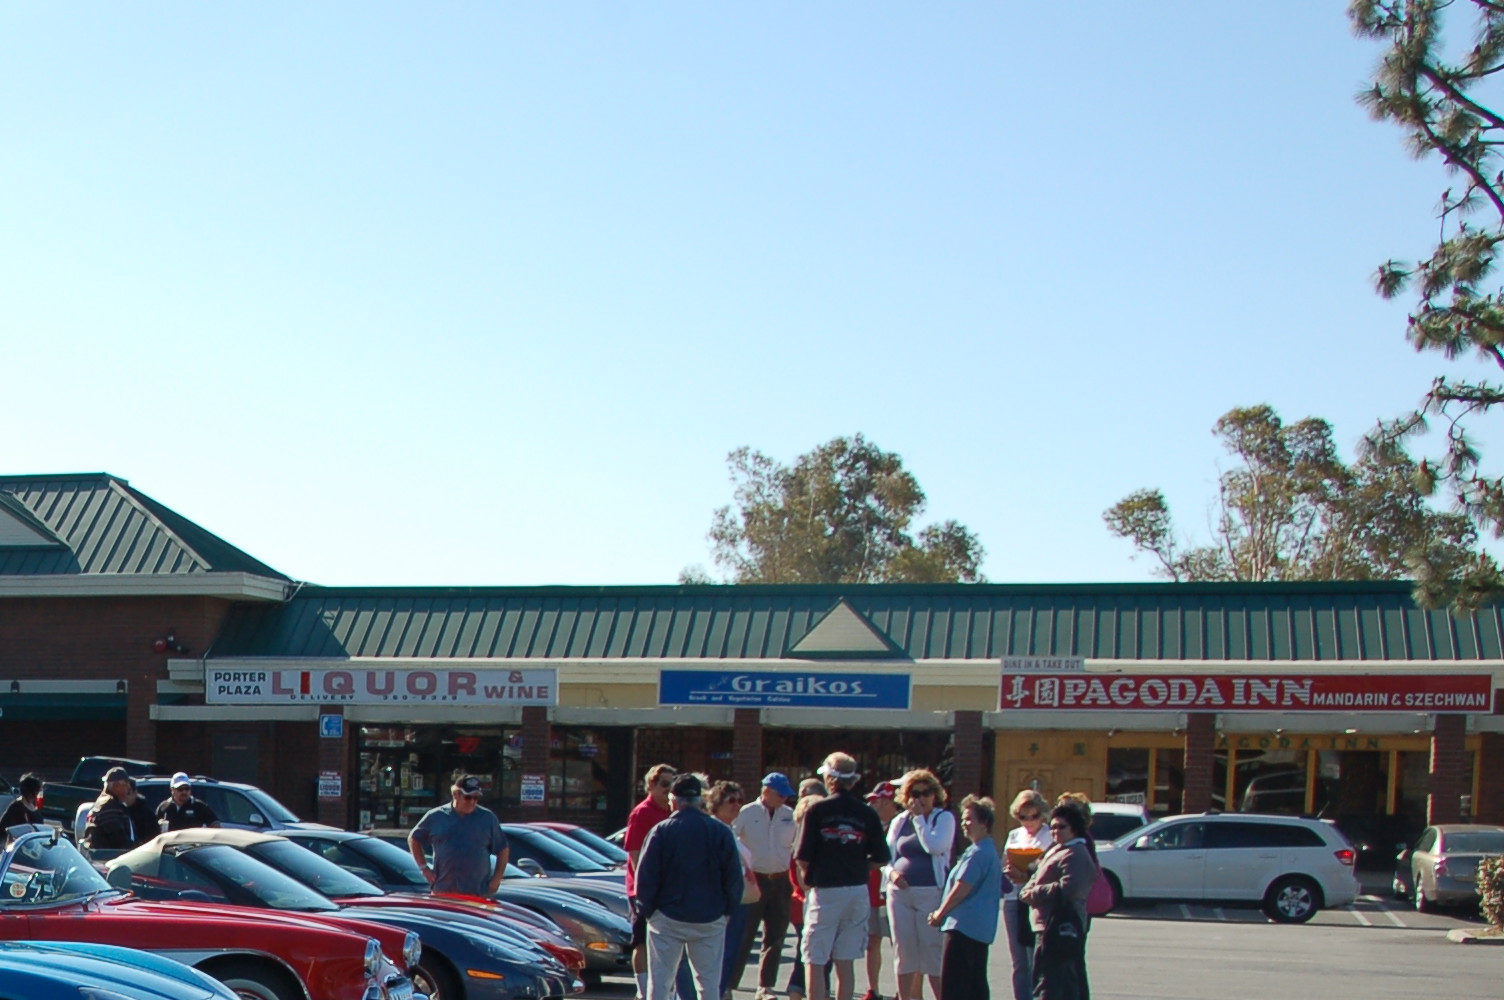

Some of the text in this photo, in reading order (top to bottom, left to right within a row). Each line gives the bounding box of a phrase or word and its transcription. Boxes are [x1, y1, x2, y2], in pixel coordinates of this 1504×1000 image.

[1024, 659, 1032, 669] IN
[1042, 659, 1062, 669] TAKE
[1064, 659, 1081, 669] OUT
[214, 671, 266, 682] PORTER
[271, 670, 524, 696] LIQUOR &
[218, 685, 262, 695] PLAZA
[483, 685, 550, 699] WINE
[731, 675, 864, 695] Graikos
[1062, 677, 1313, 706] PAGODA INN
[1313, 692, 1486, 707] MANDARIN & SZECHWAN
[1220, 737, 1379, 749] AGODA INN
